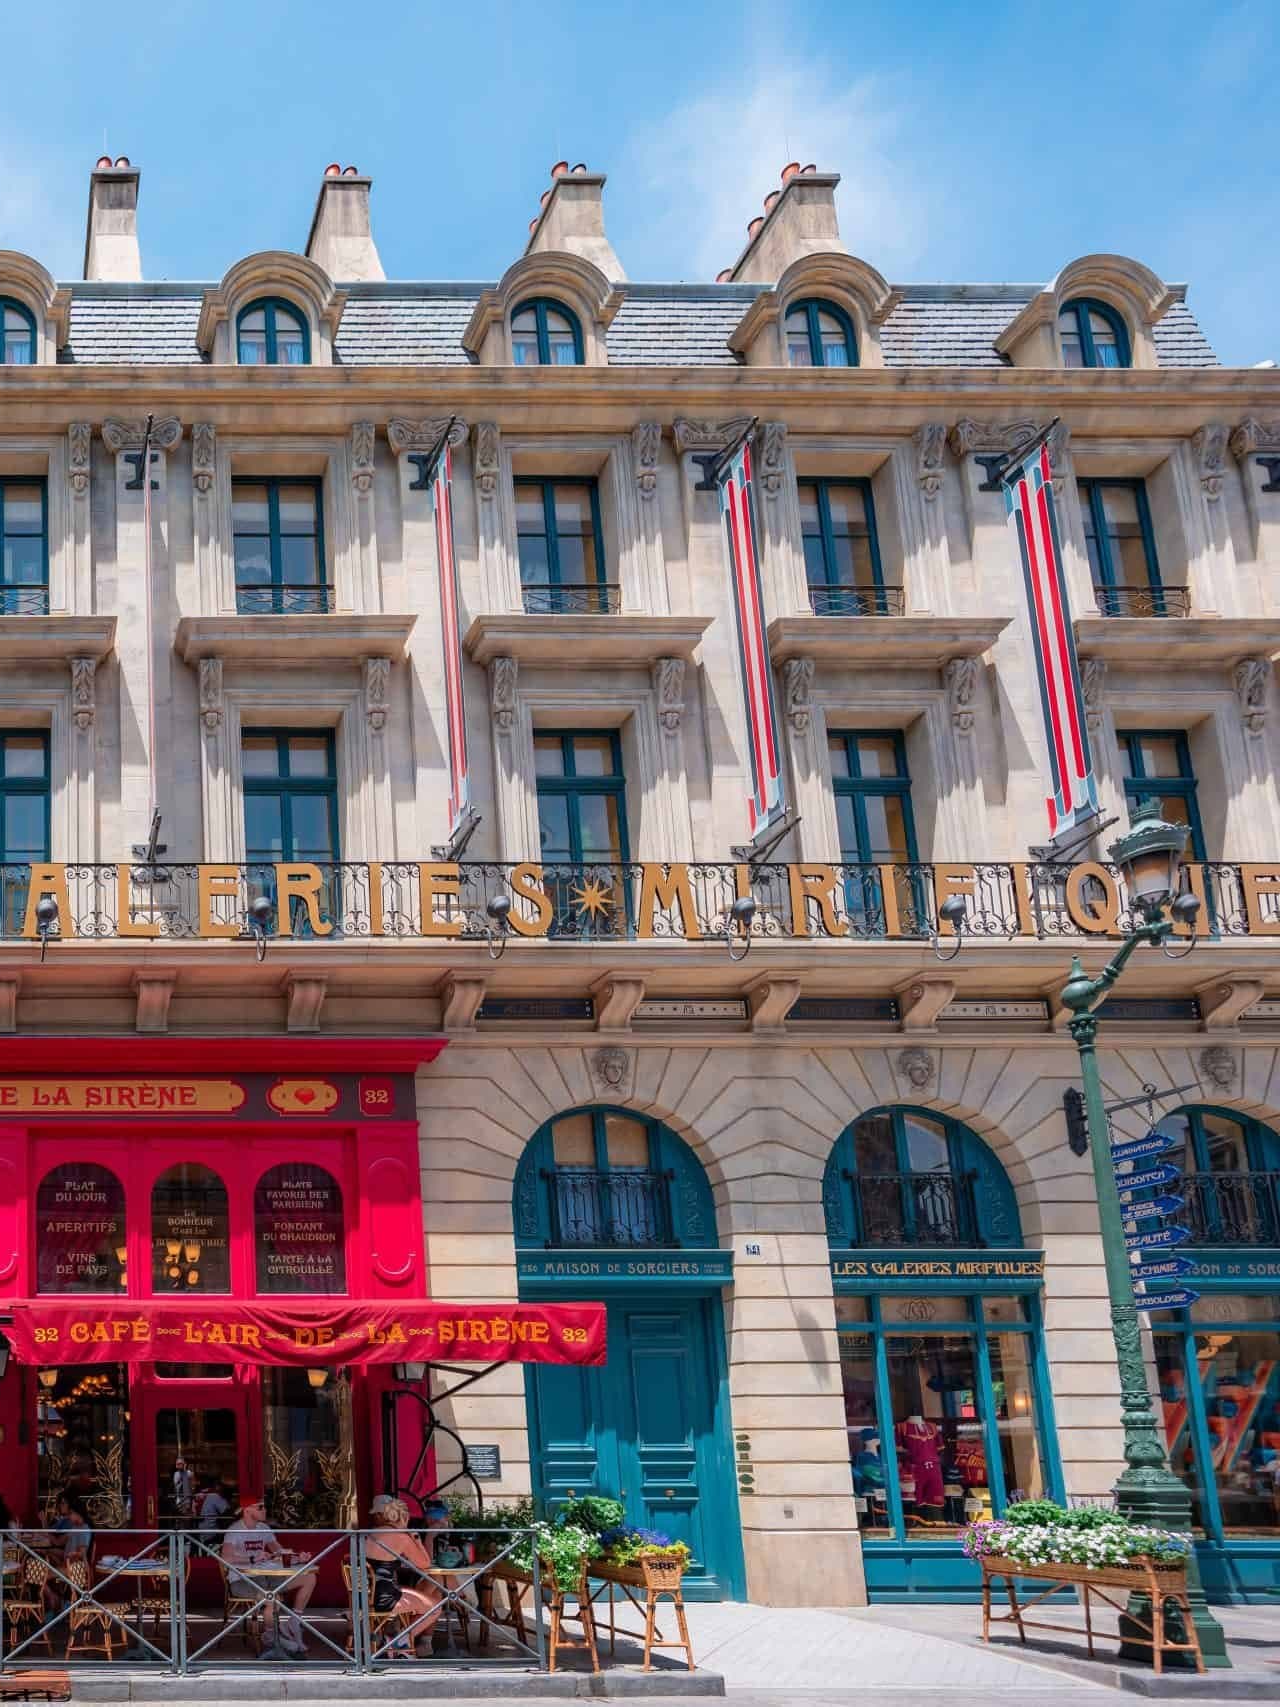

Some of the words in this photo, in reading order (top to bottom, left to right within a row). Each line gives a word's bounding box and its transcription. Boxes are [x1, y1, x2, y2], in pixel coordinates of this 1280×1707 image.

[32, 1086, 72, 1106] LA
[85, 1083, 197, 1108] SIRÈNE
[365, 1089, 388, 1104] 32
[64, 1181, 96, 1191] PLAT
[56, 1192, 72, 1202] DU
[75, 1192, 107, 1203] JOUR
[273, 1222, 323, 1232] FONDANT
[263, 1232, 277, 1241] DU
[280, 1232, 336, 1242] CHAUDRON
[67, 1253, 96, 1264] VINS
[267, 1255, 304, 1264] TARTE
[56, 1264, 73, 1274] DE
[77, 1265, 108, 1275] PAYS
[267, 1265, 335, 1275] CITROUILLE
[544, 1263, 600, 1275] MAISON
[627, 1263, 701, 1275] SORCIERS
[833, 1262, 868, 1275] LES
[871, 1262, 952, 1275] GALERIES
[34, 1327, 59, 1342] 32
[70, 1316, 152, 1344] CAFÉ
[184, 1321, 262, 1348] L'AIR
[294, 1327, 336, 1348] DE
[367, 1322, 409, 1344] LA
[438, 1316, 550, 1344] SIRÈNE
[562, 1327, 589, 1343] 32
